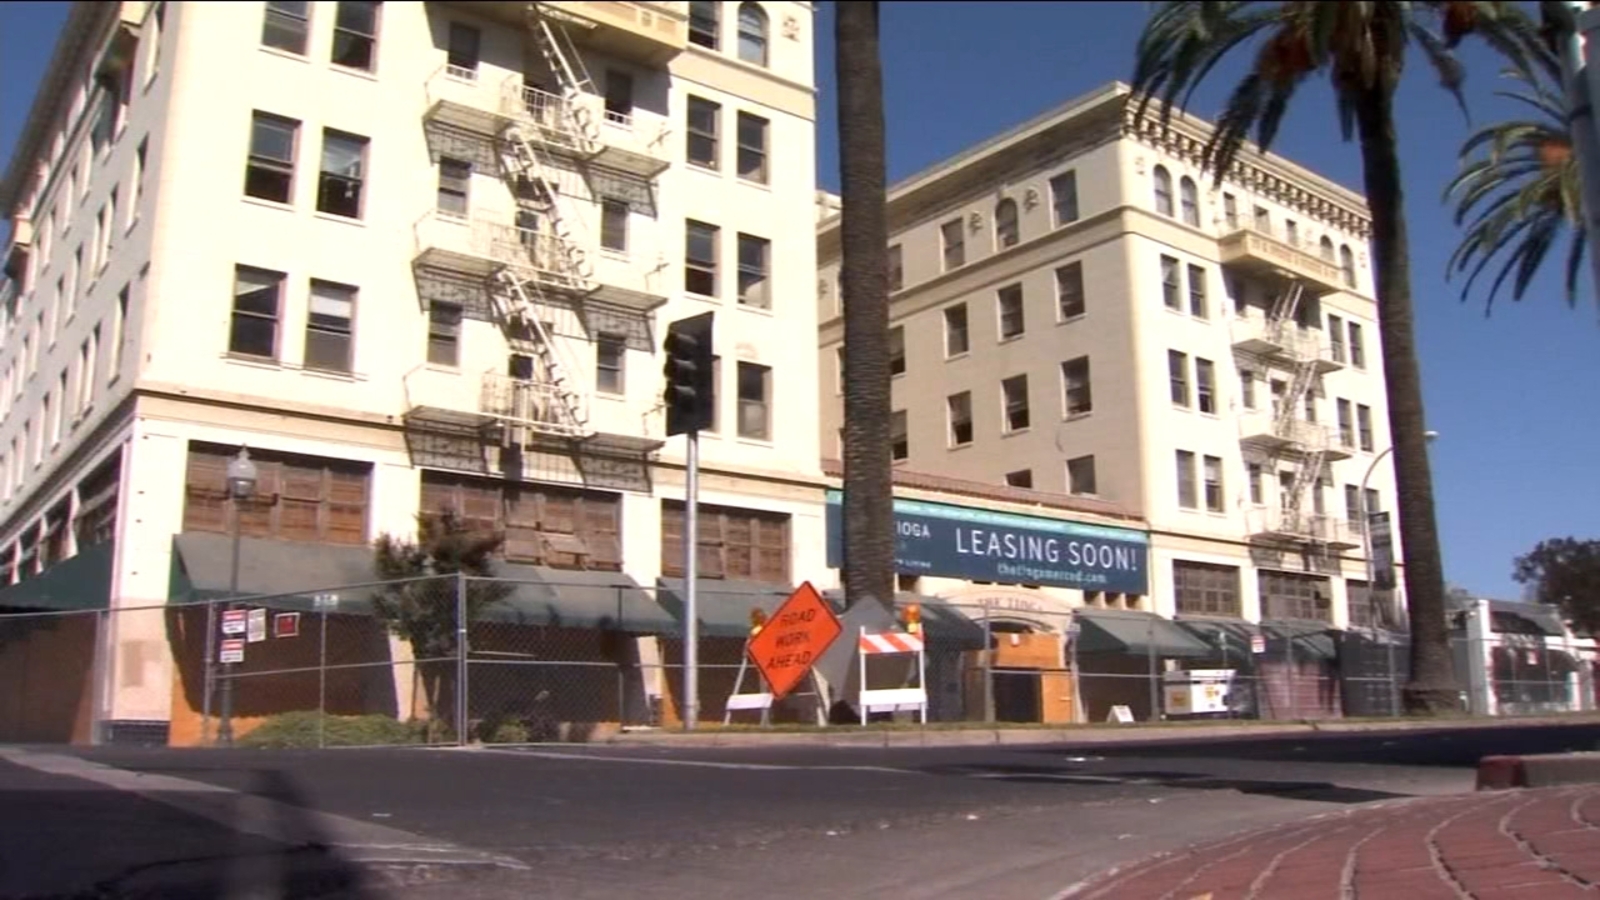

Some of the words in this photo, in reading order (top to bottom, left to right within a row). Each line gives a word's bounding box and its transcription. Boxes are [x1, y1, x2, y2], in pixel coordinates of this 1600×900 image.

[895, 520, 931, 538] IOGA
[955, 527, 1060, 563] LEASING
[1068, 541, 1138, 572] SOON!
[780, 609, 816, 626] ROAD
[775, 631, 811, 648] WORK
[766, 651, 812, 670] AHEAD
